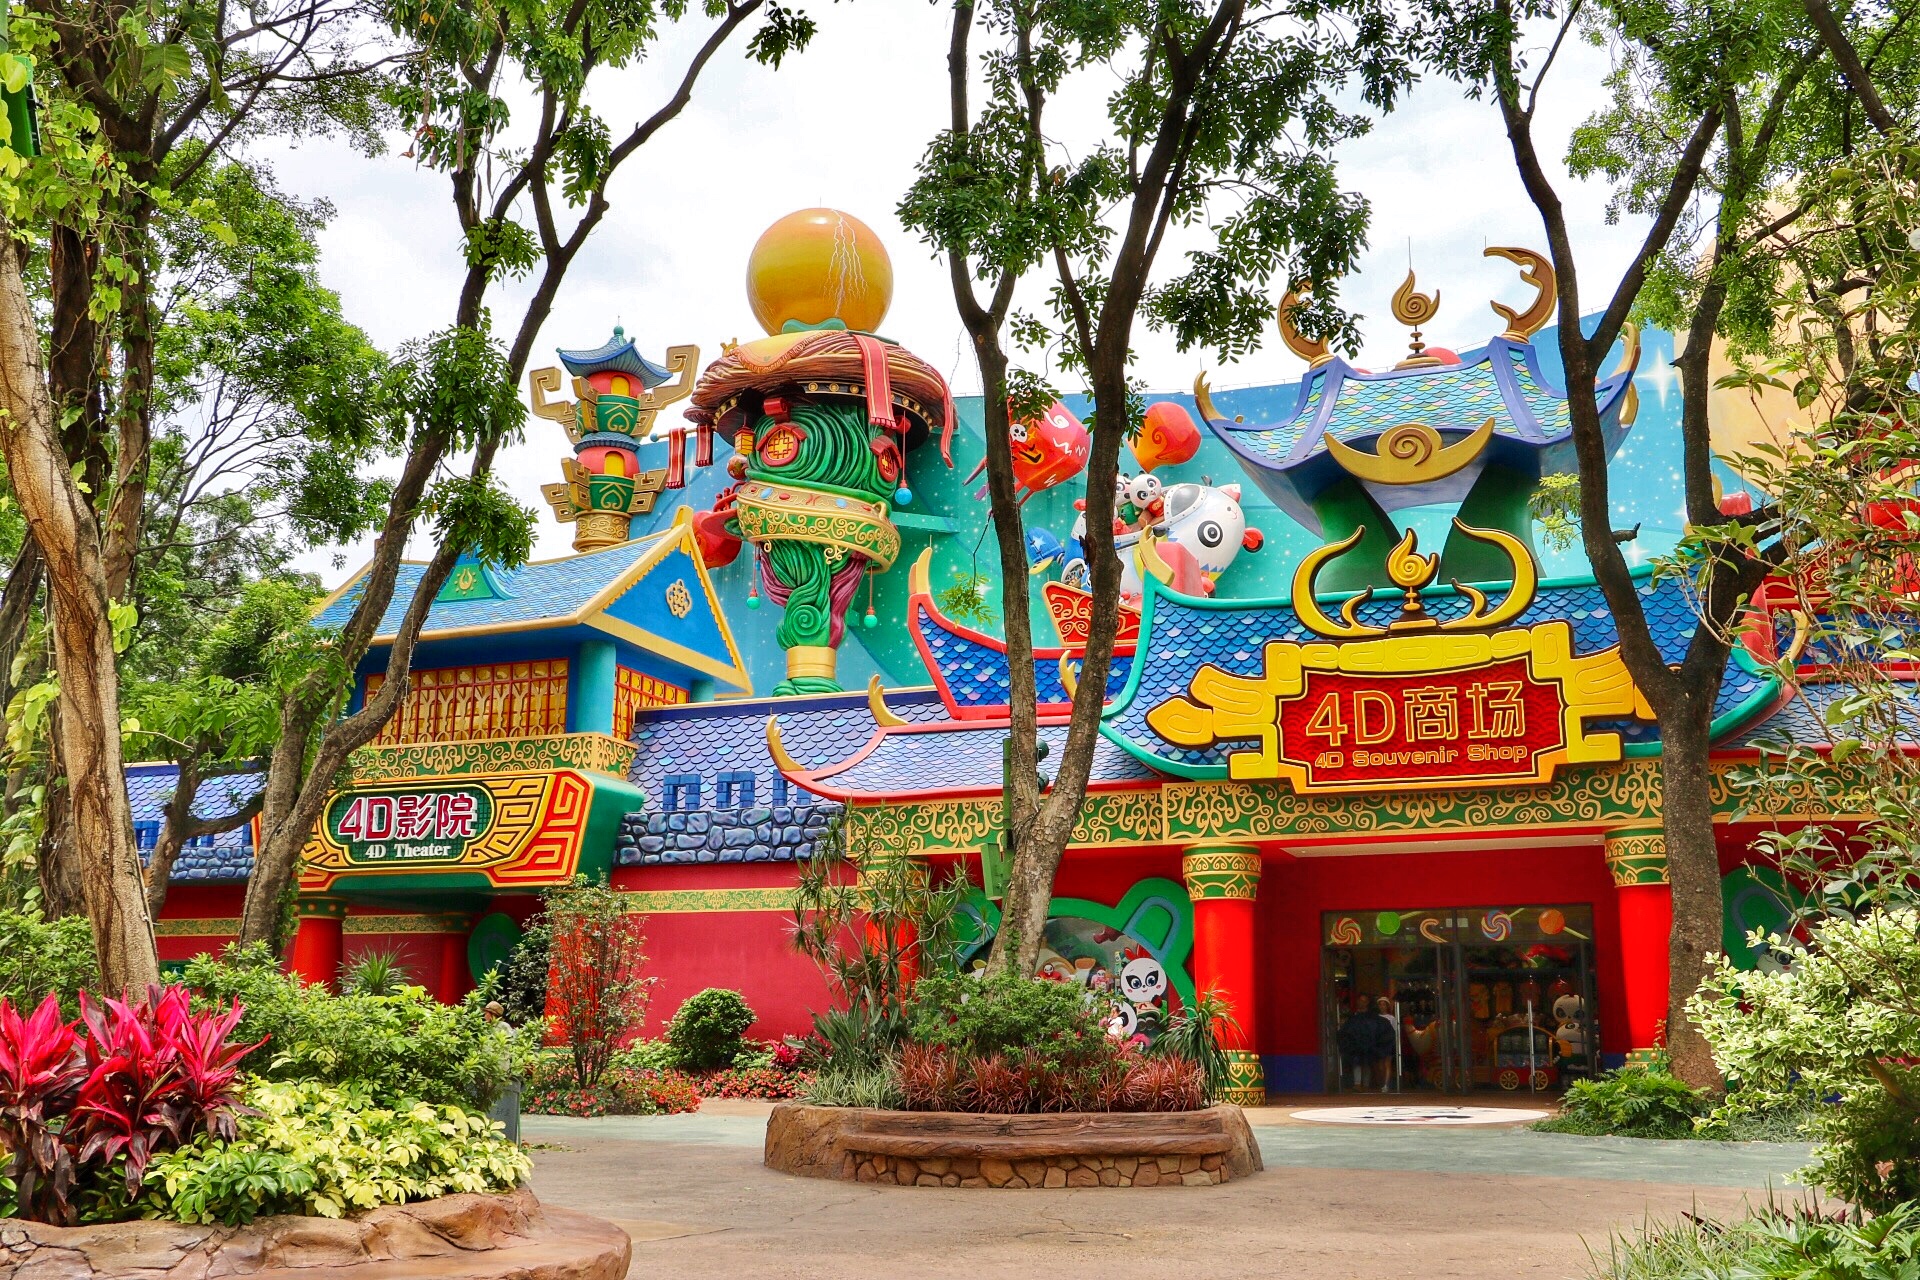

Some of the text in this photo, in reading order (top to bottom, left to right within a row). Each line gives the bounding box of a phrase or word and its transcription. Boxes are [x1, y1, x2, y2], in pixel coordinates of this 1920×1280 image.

[1306, 680, 1526, 747] 4D商场
[1314, 744, 1527, 769] 4D Souvenir Shop
[338, 792, 477, 842] 4D影院
[365, 843, 451, 859] 4D Theater
